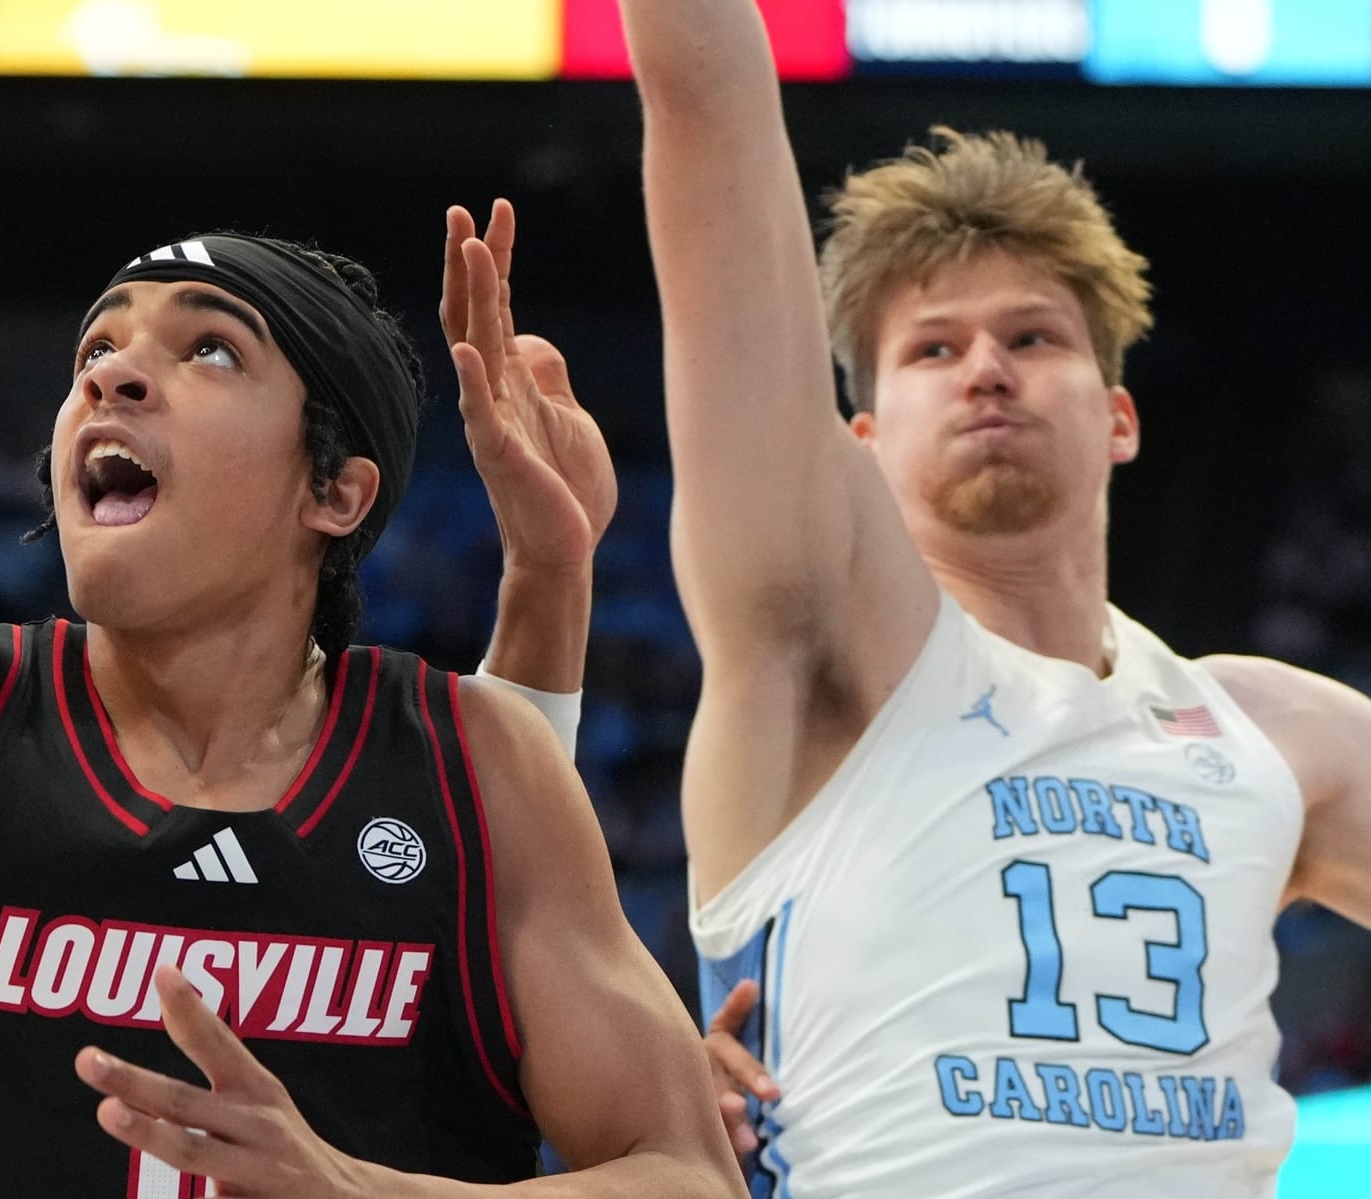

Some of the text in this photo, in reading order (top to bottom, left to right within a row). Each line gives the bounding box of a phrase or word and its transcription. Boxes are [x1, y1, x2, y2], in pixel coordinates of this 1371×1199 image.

[367, 839, 421, 858] ACC
[985, 776, 1211, 863] NORTH
[1001, 859, 1209, 1055] 13
[933, 1054, 1246, 1141] CAROLINA
